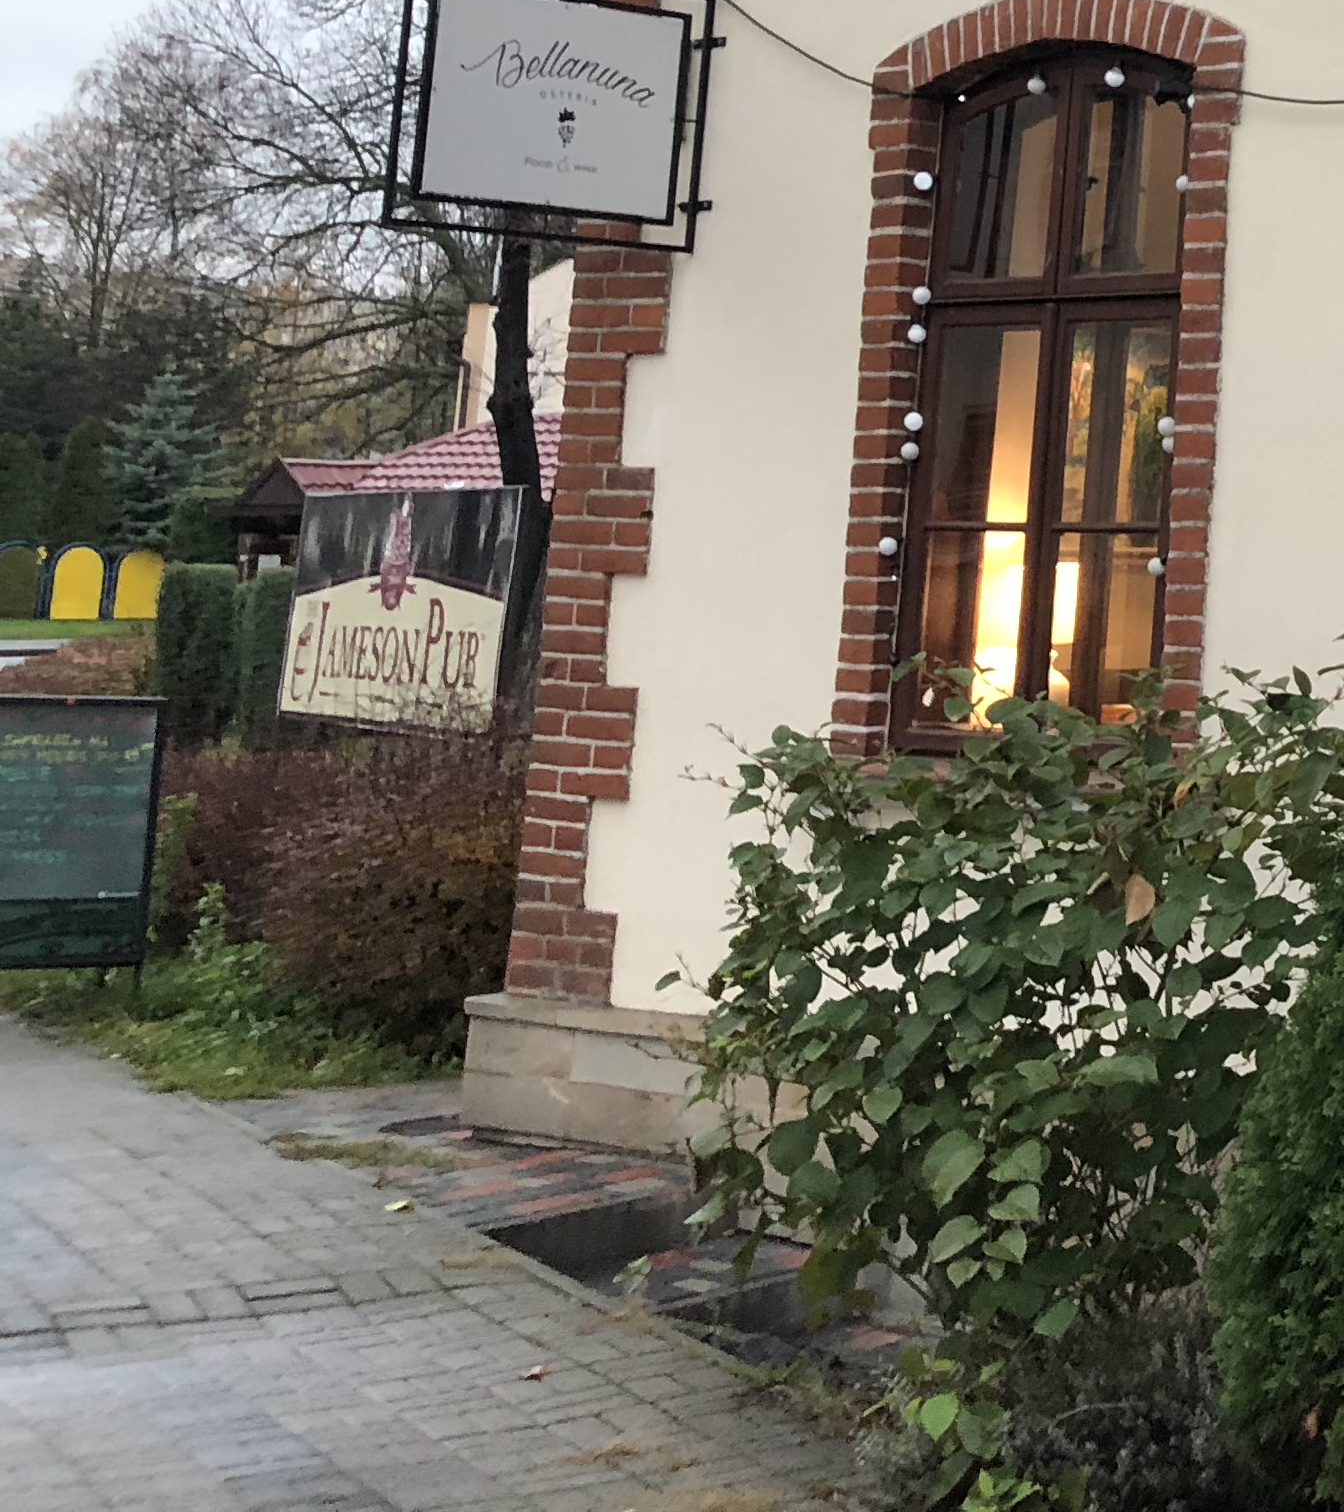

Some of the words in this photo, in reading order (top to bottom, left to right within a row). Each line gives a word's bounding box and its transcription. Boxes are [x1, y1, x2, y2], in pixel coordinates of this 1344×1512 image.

[460, 39, 655, 108] Bellanuna
[308, 601, 421, 703] JAMESON
[421, 598, 480, 692] PUB
